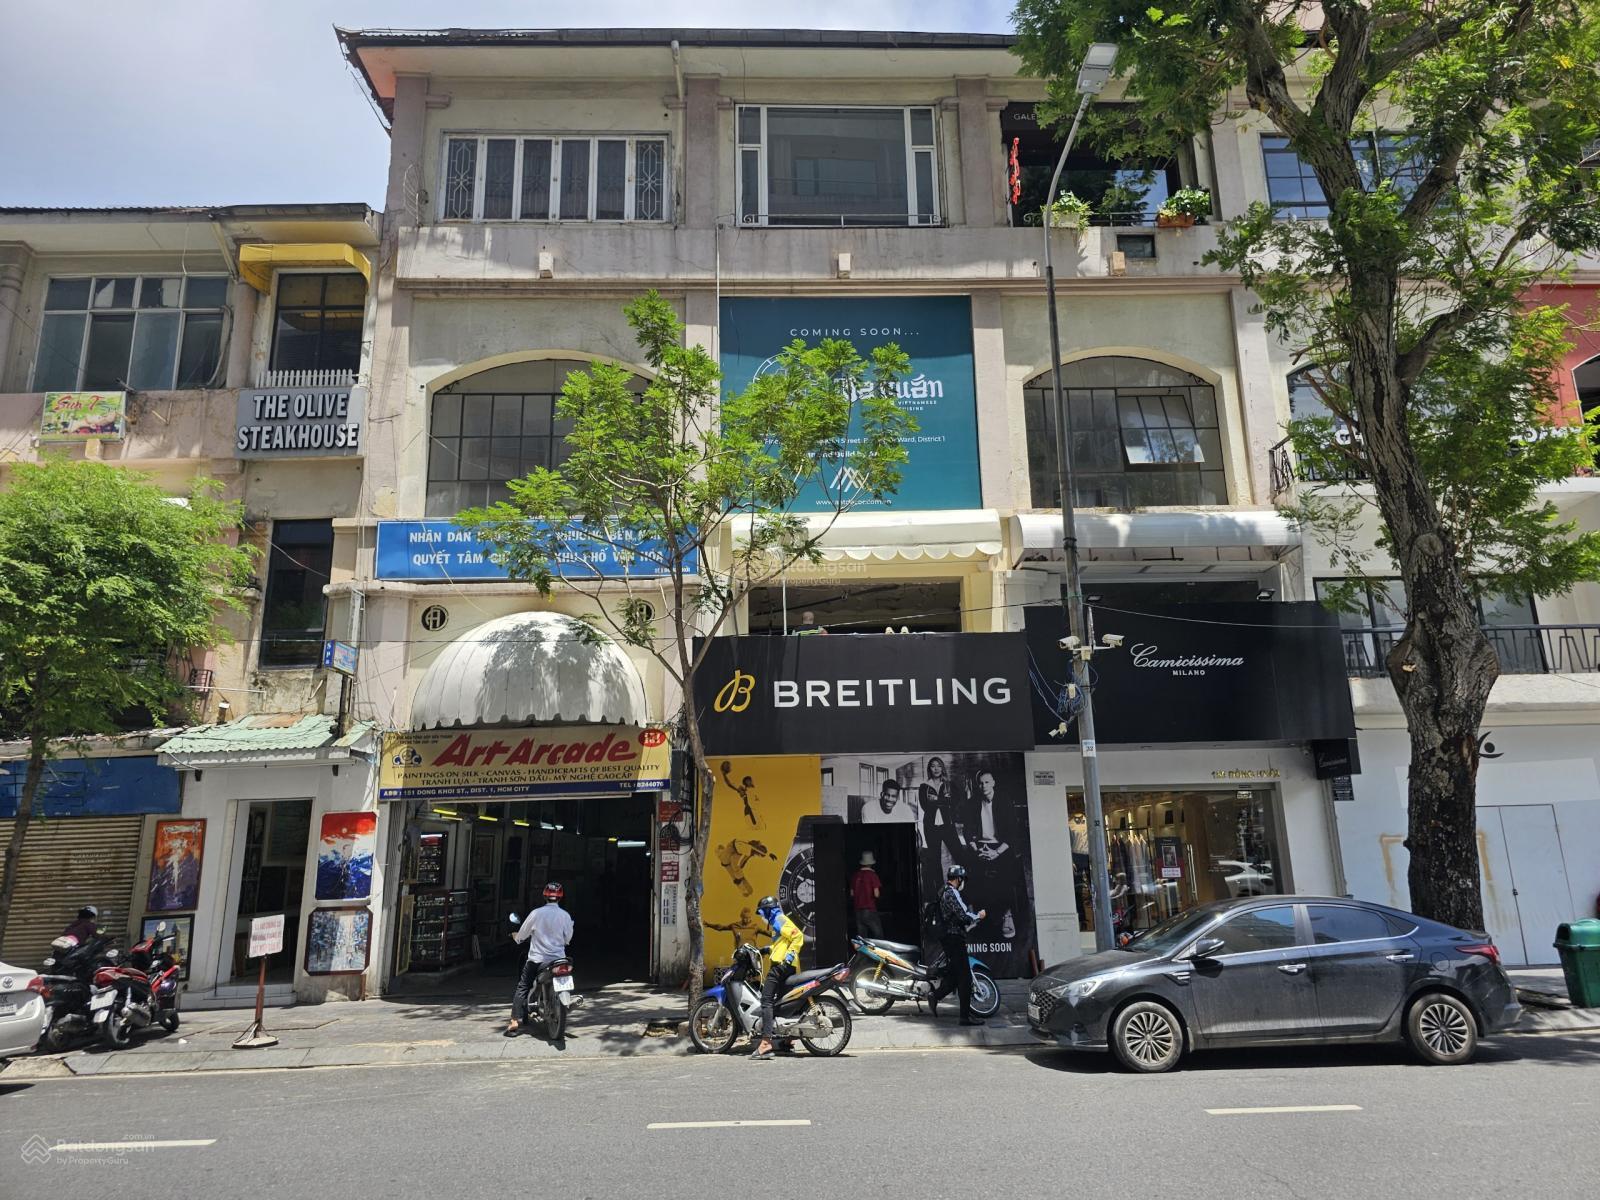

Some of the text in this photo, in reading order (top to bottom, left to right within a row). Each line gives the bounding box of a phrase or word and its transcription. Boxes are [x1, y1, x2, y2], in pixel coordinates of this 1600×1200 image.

[790, 327, 920, 337] COMING SOON...
[254, 393, 349, 419] THE OLIVE
[237, 424, 358, 450] STEAKHOUSE
[918, 435, 941, 443] District
[409, 530, 442, 543] NHÂN
[413, 550, 451, 566] QUYẾT
[457, 551, 483, 564] TÂM
[1130, 643, 1244, 668] Camicissima
[773, 677, 1011, 708] BREITLING
[431, 732, 637, 767] Art Arcade
[397, 771, 444, 780] PAINTINGS
[528, 766, 588, 775] HANDICRAFTS
[590, 765, 600, 773] OF
[601, 765, 622, 773] BEST
[623, 764, 660, 773] QUALITY
[989, 942, 1012, 952] SOON
